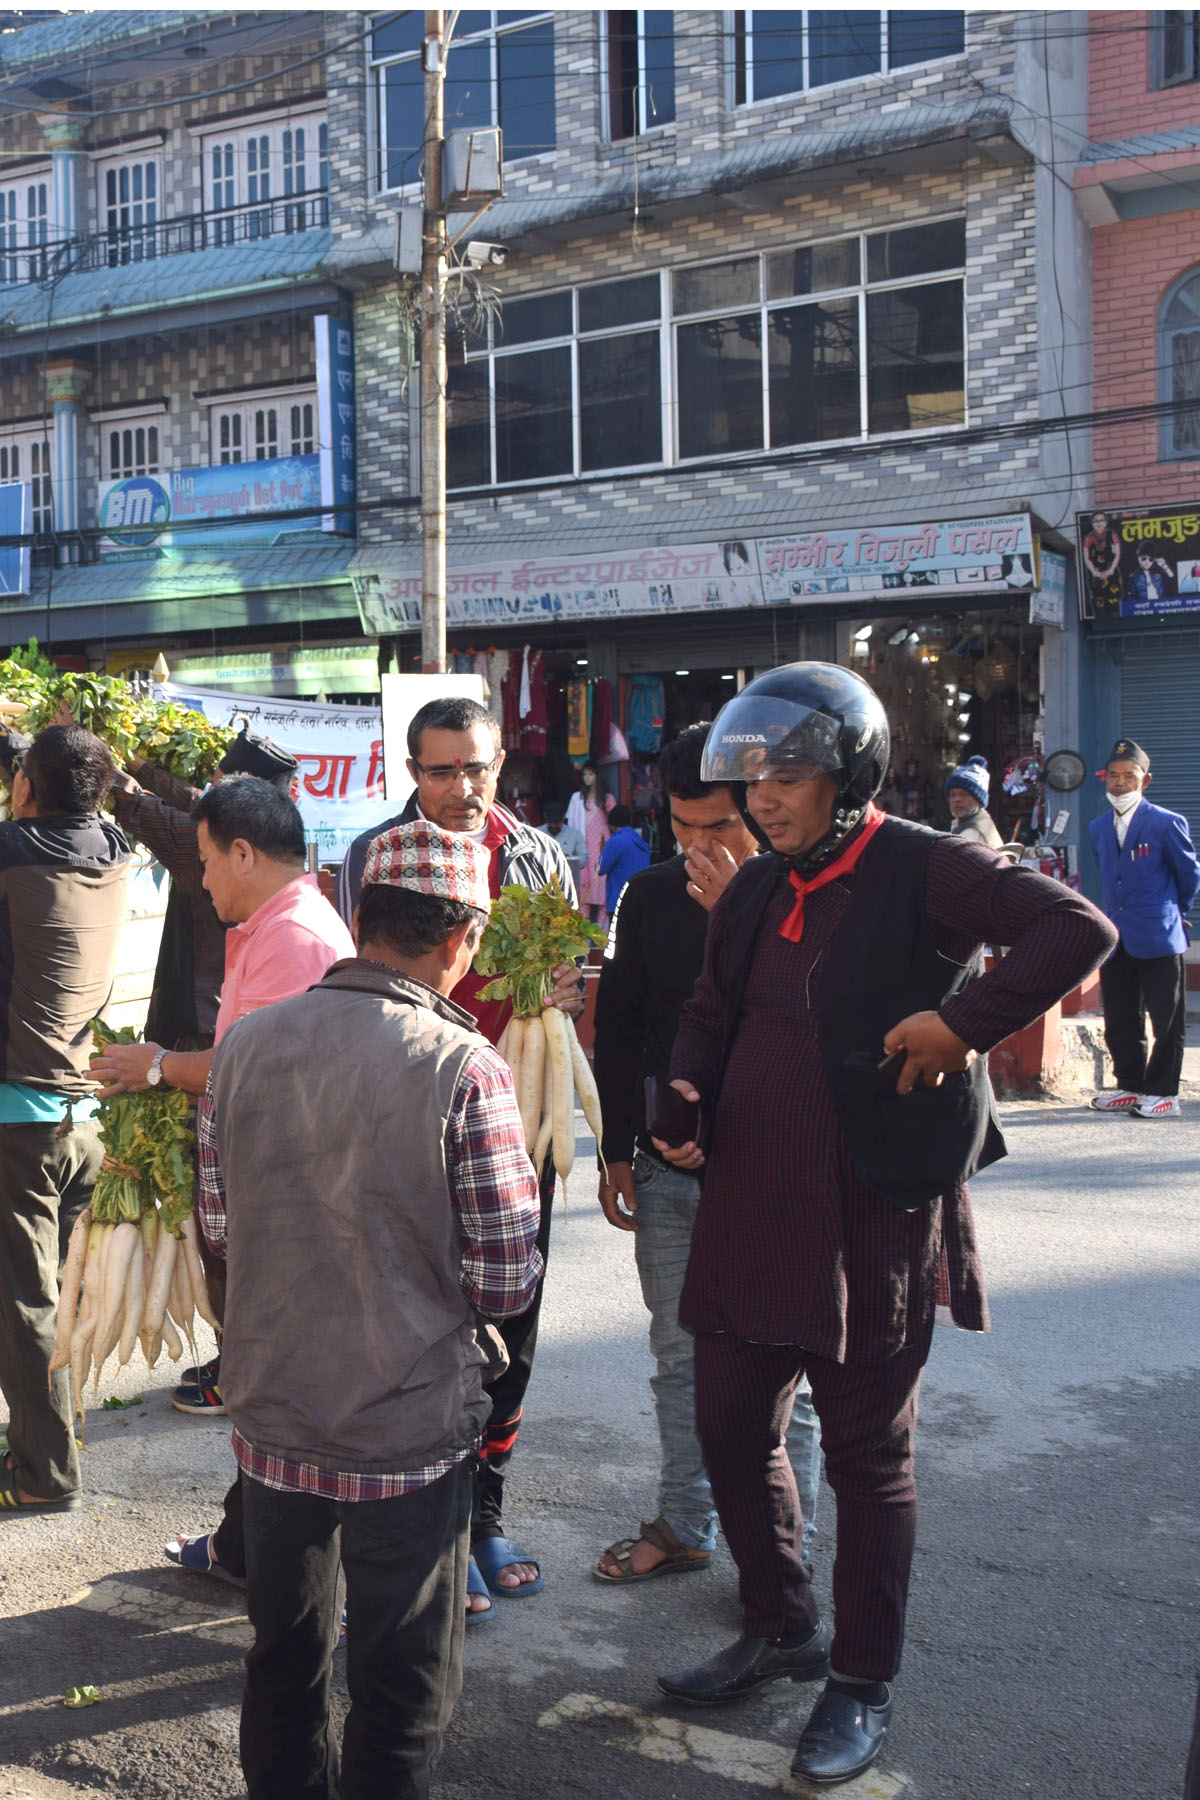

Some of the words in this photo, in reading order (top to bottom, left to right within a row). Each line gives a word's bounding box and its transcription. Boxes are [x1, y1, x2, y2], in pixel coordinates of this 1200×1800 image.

[173, 472, 194, 496] Big
[254, 481, 277, 505] Net
[106, 488, 154, 527] BM
[854, 525, 940, 571] विजुली
[948, 524, 1023, 556] पसल
[722, 734, 768, 743] HONDA
